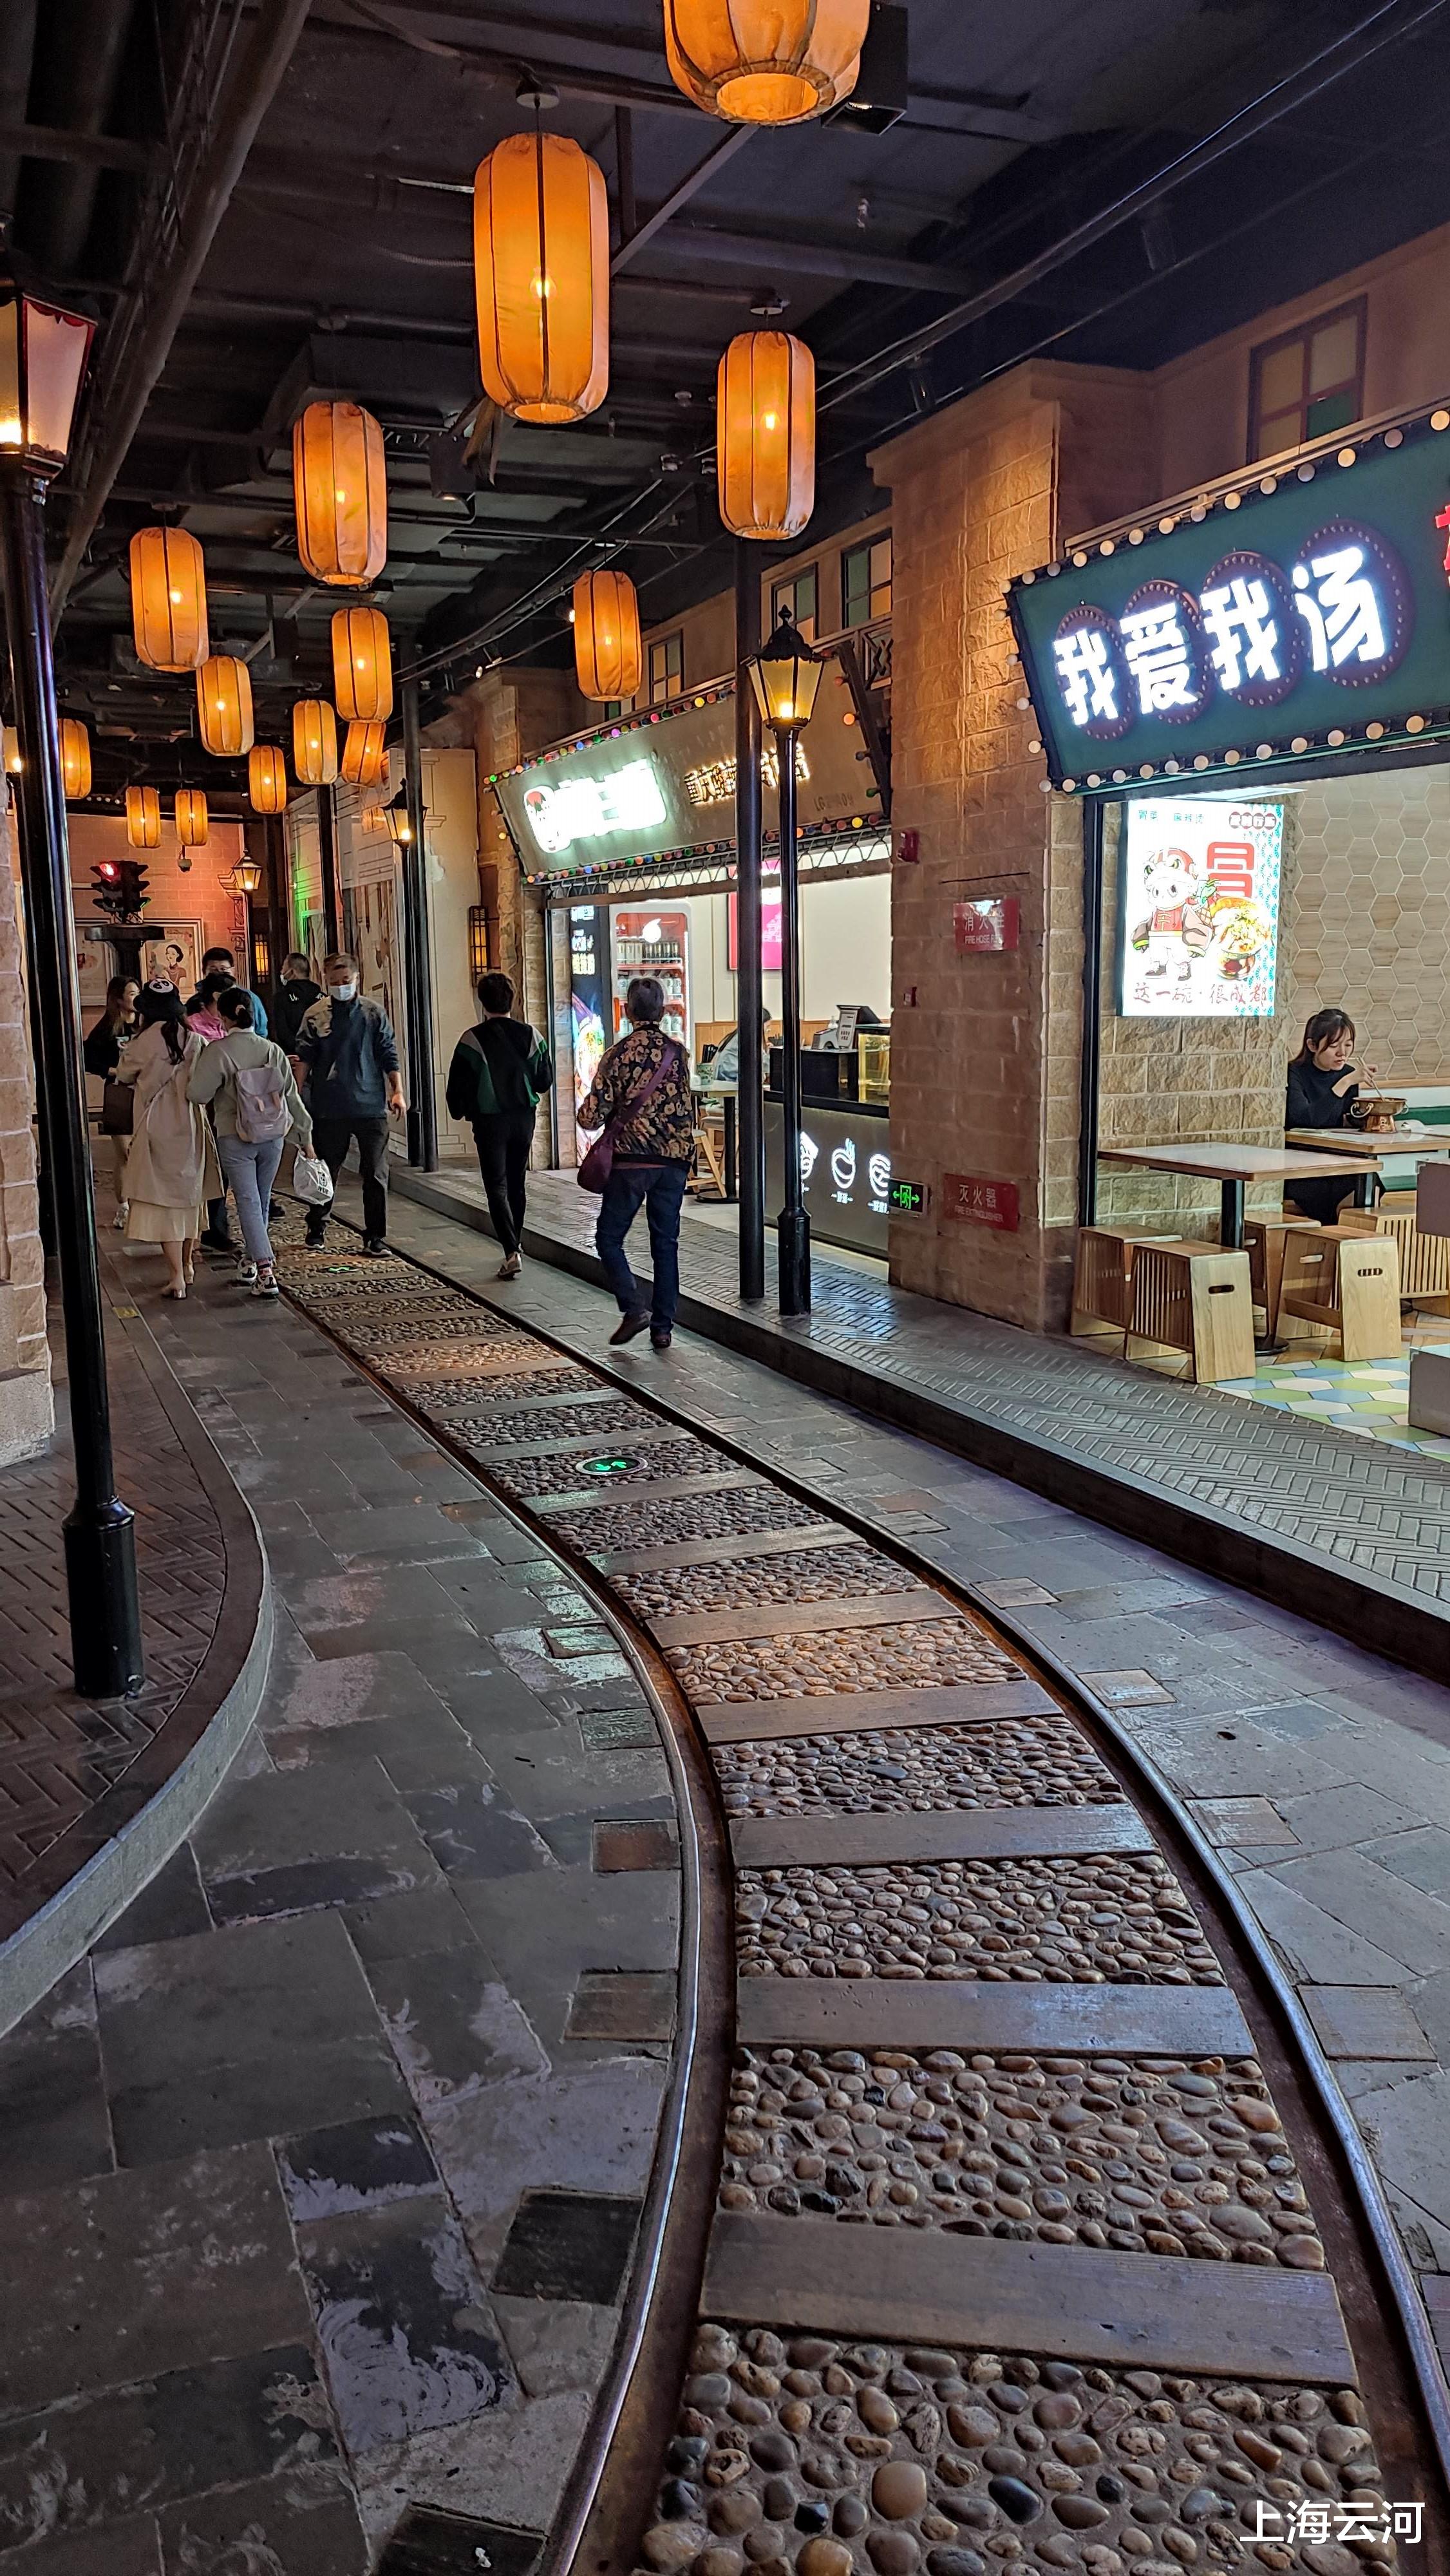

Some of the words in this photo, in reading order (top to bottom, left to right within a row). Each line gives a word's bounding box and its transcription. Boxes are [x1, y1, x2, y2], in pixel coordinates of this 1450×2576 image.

[1053, 545, 1386, 726] 我爱我汤
[959, 1184, 997, 1208] 灭火器
